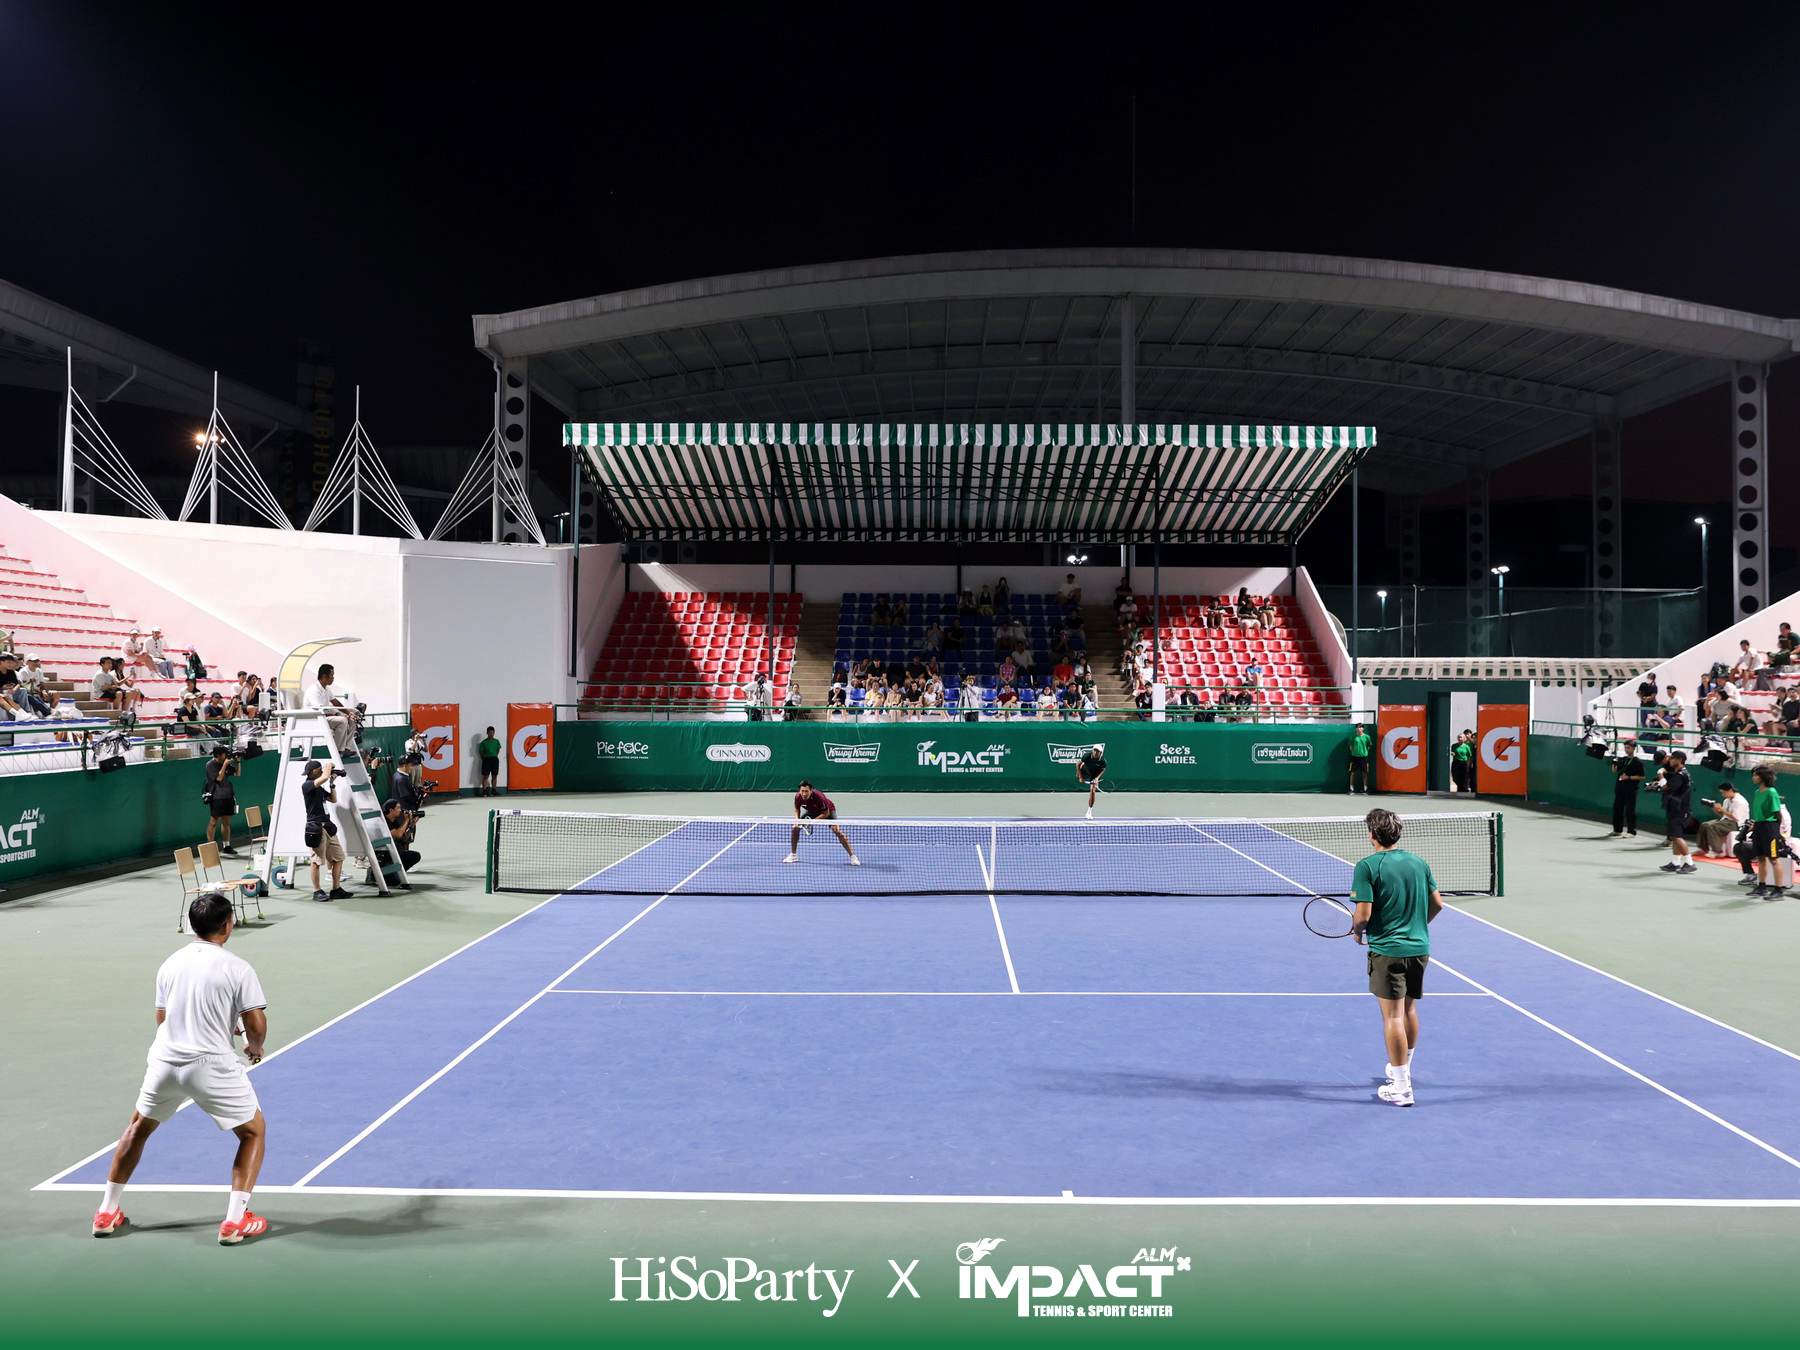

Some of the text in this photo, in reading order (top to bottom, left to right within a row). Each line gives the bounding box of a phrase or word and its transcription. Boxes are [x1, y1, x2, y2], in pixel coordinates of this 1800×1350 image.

[311, 375, 333, 526] CLUBHOU
[512, 724, 548, 768] G
[617, 741, 649, 755] face
[710, 748, 766, 758] CINNABON
[828, 747, 877, 758] Krispy Kreme
[986, 743, 1005, 752] ALM
[1160, 743, 1191, 755] See's
[1381, 726, 1419, 770] G
[1480, 726, 1521, 772] G
[20, 807, 40, 823] ALM
